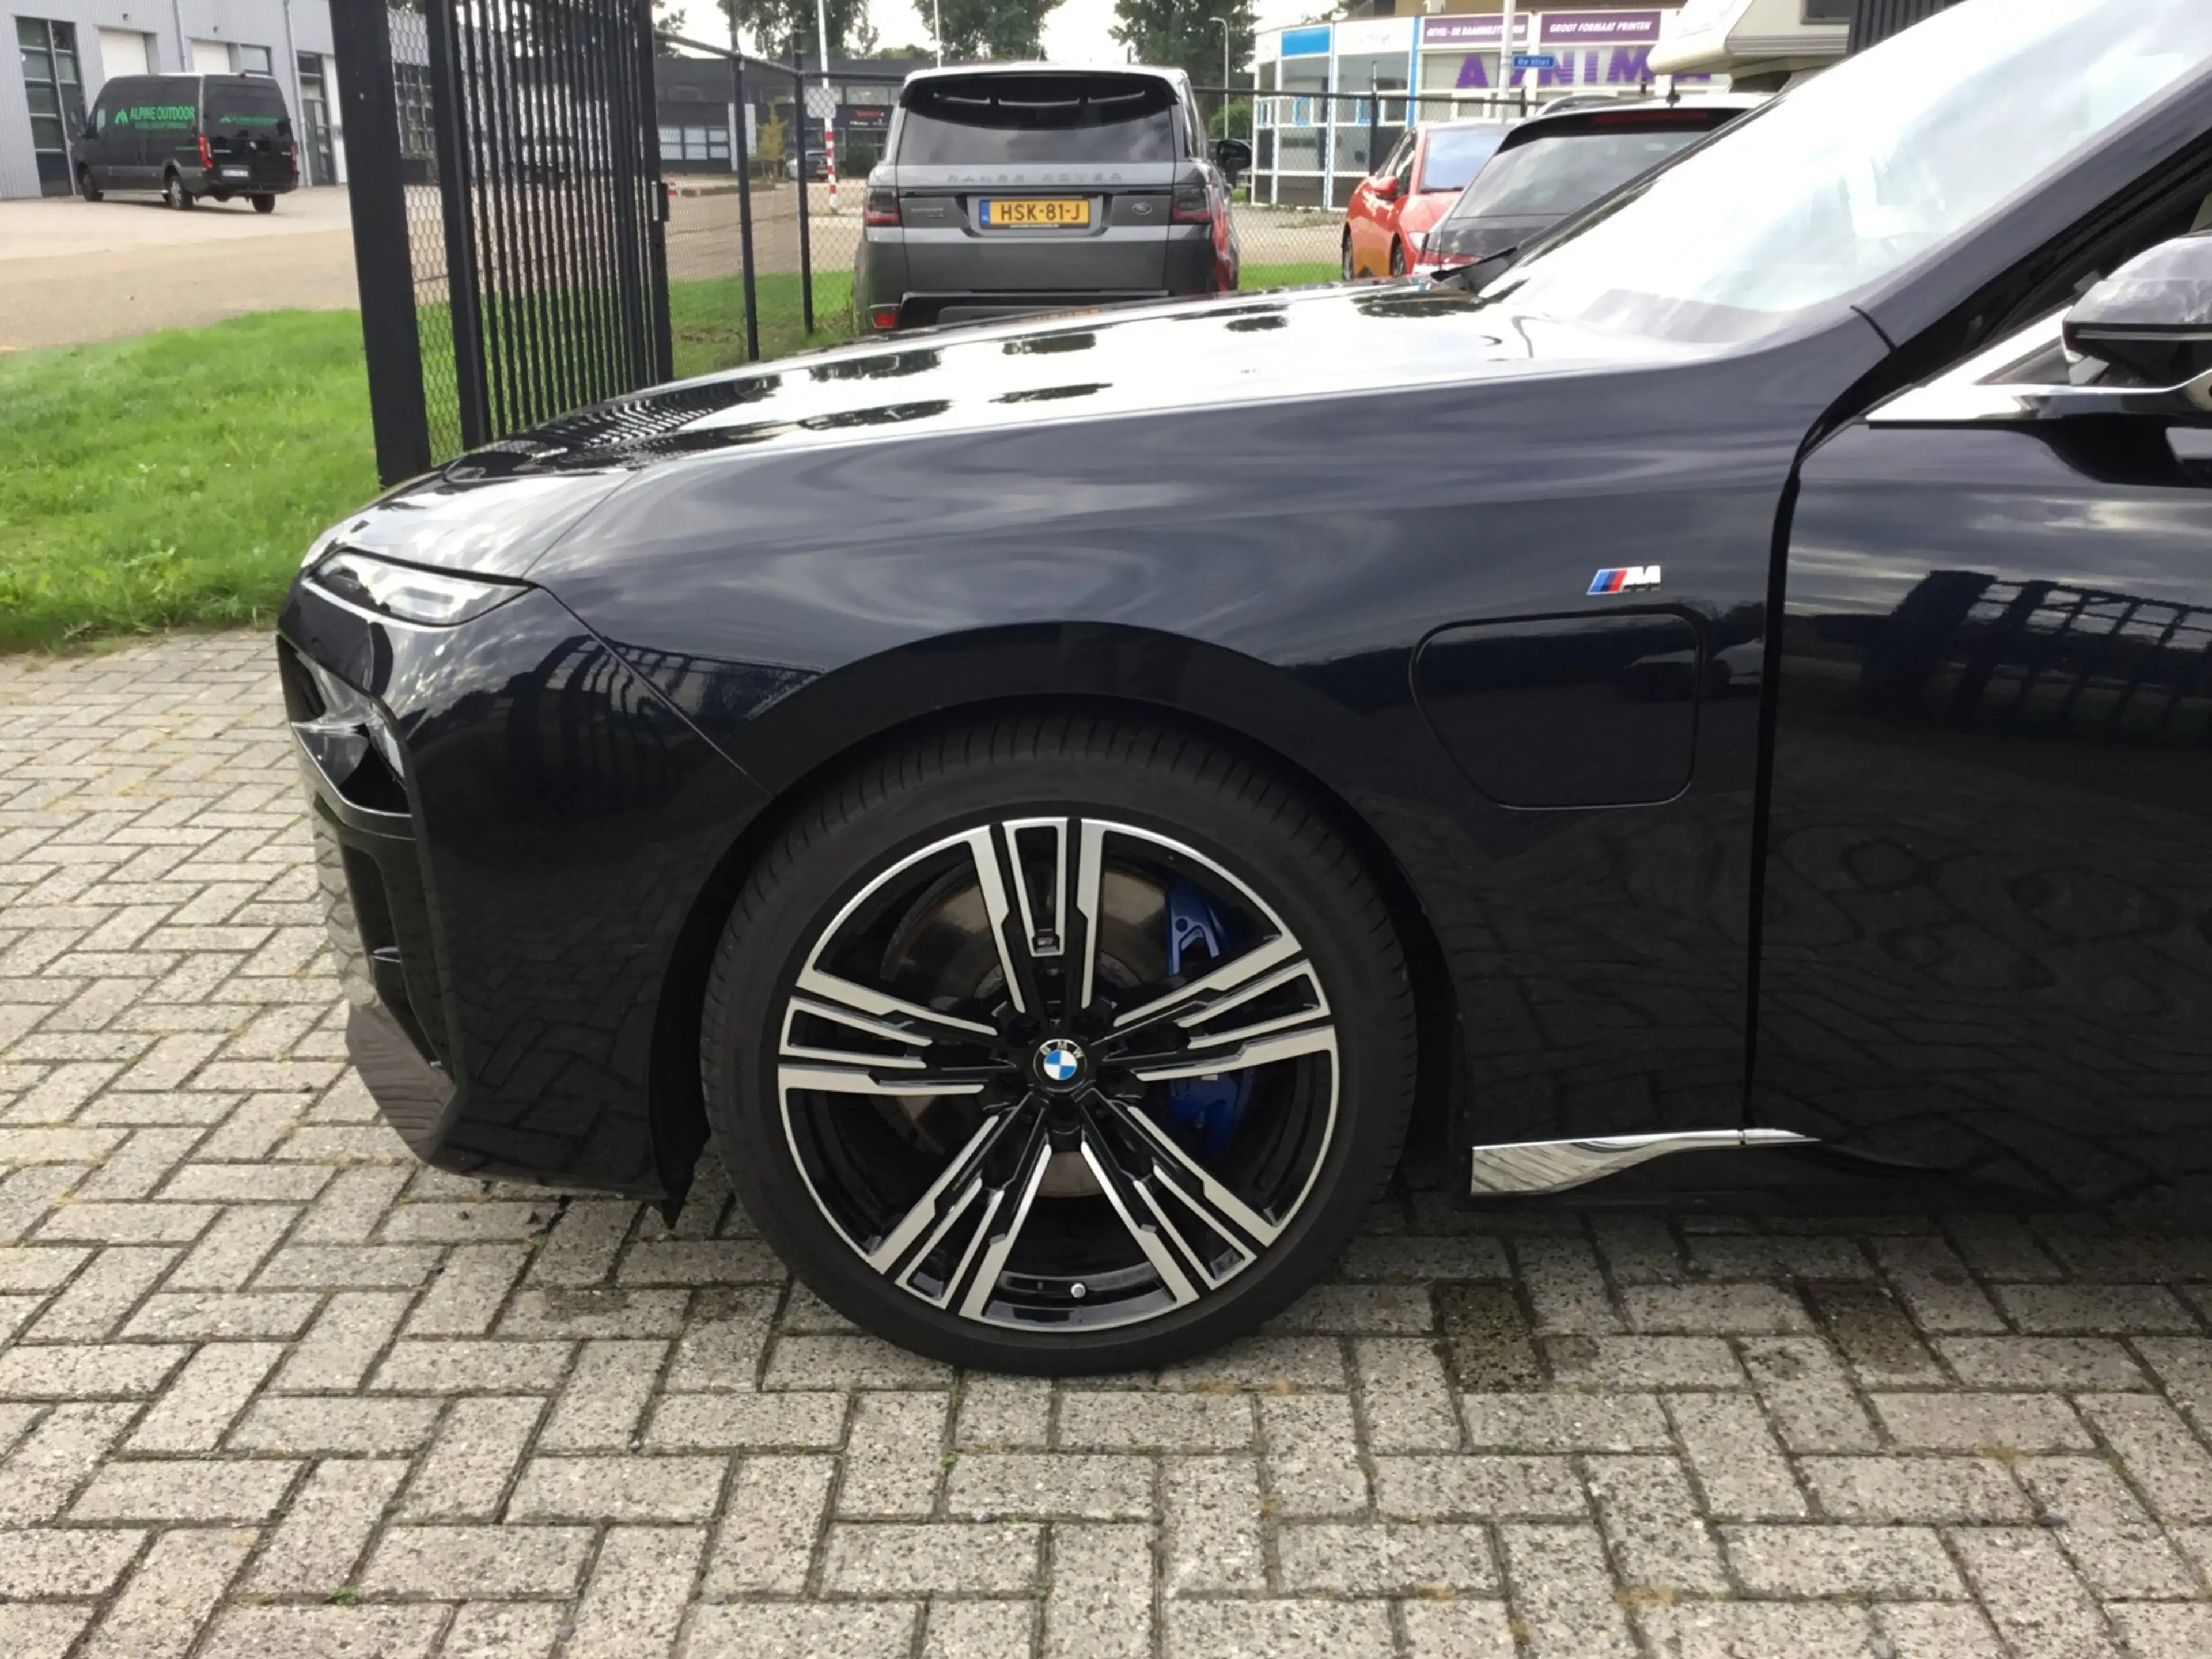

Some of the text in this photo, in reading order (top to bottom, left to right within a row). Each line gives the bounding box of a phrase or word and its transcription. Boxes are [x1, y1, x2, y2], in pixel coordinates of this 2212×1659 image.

[1550, 20, 1652, 33] GROOT FORMAAT PRINTEN
[130, 105, 195, 120] ALPINE OUTDOOR
[1041, 173, 1123, 182] ROVER
[999, 203, 1081, 221] HSK-81-J
[1040, 1040, 1085, 1059] BMW
